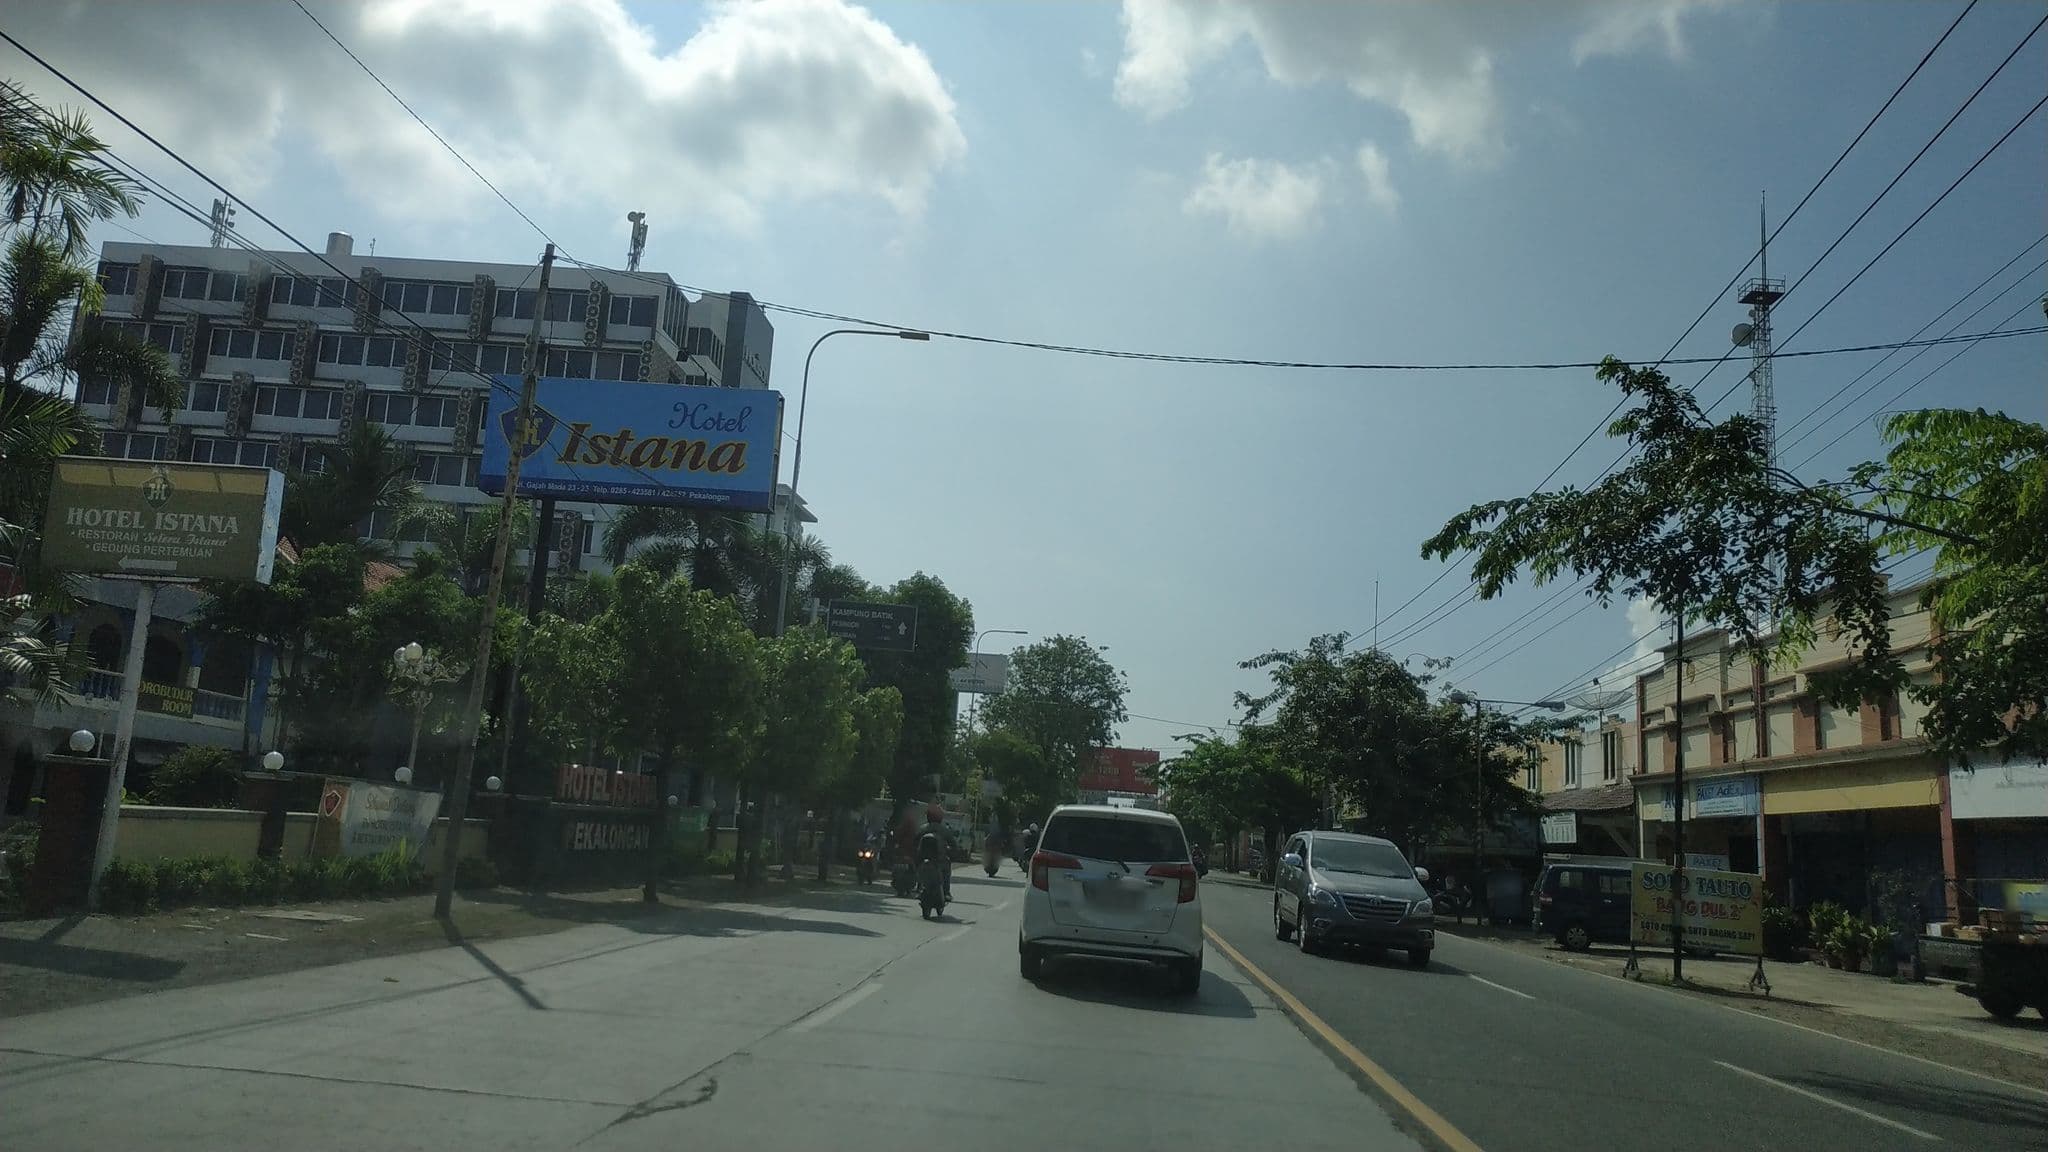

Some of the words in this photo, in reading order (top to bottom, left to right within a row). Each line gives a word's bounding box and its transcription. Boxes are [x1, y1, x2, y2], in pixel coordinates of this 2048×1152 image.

[668, 401, 752, 433] Hotel
[556, 421, 749, 475] Istana
[66, 507, 145, 529] HOTEL
[154, 512, 239, 534] ISTANA
[78, 529, 138, 542] RESTORAN
[92, 542, 140, 554] GEDUNG
[143, 545, 213, 558] PERTEMUAN
[871, 611, 894, 620] BATIK
[162, 699, 192, 714] ROOM
[1696, 877, 1752, 900] TAUTO
